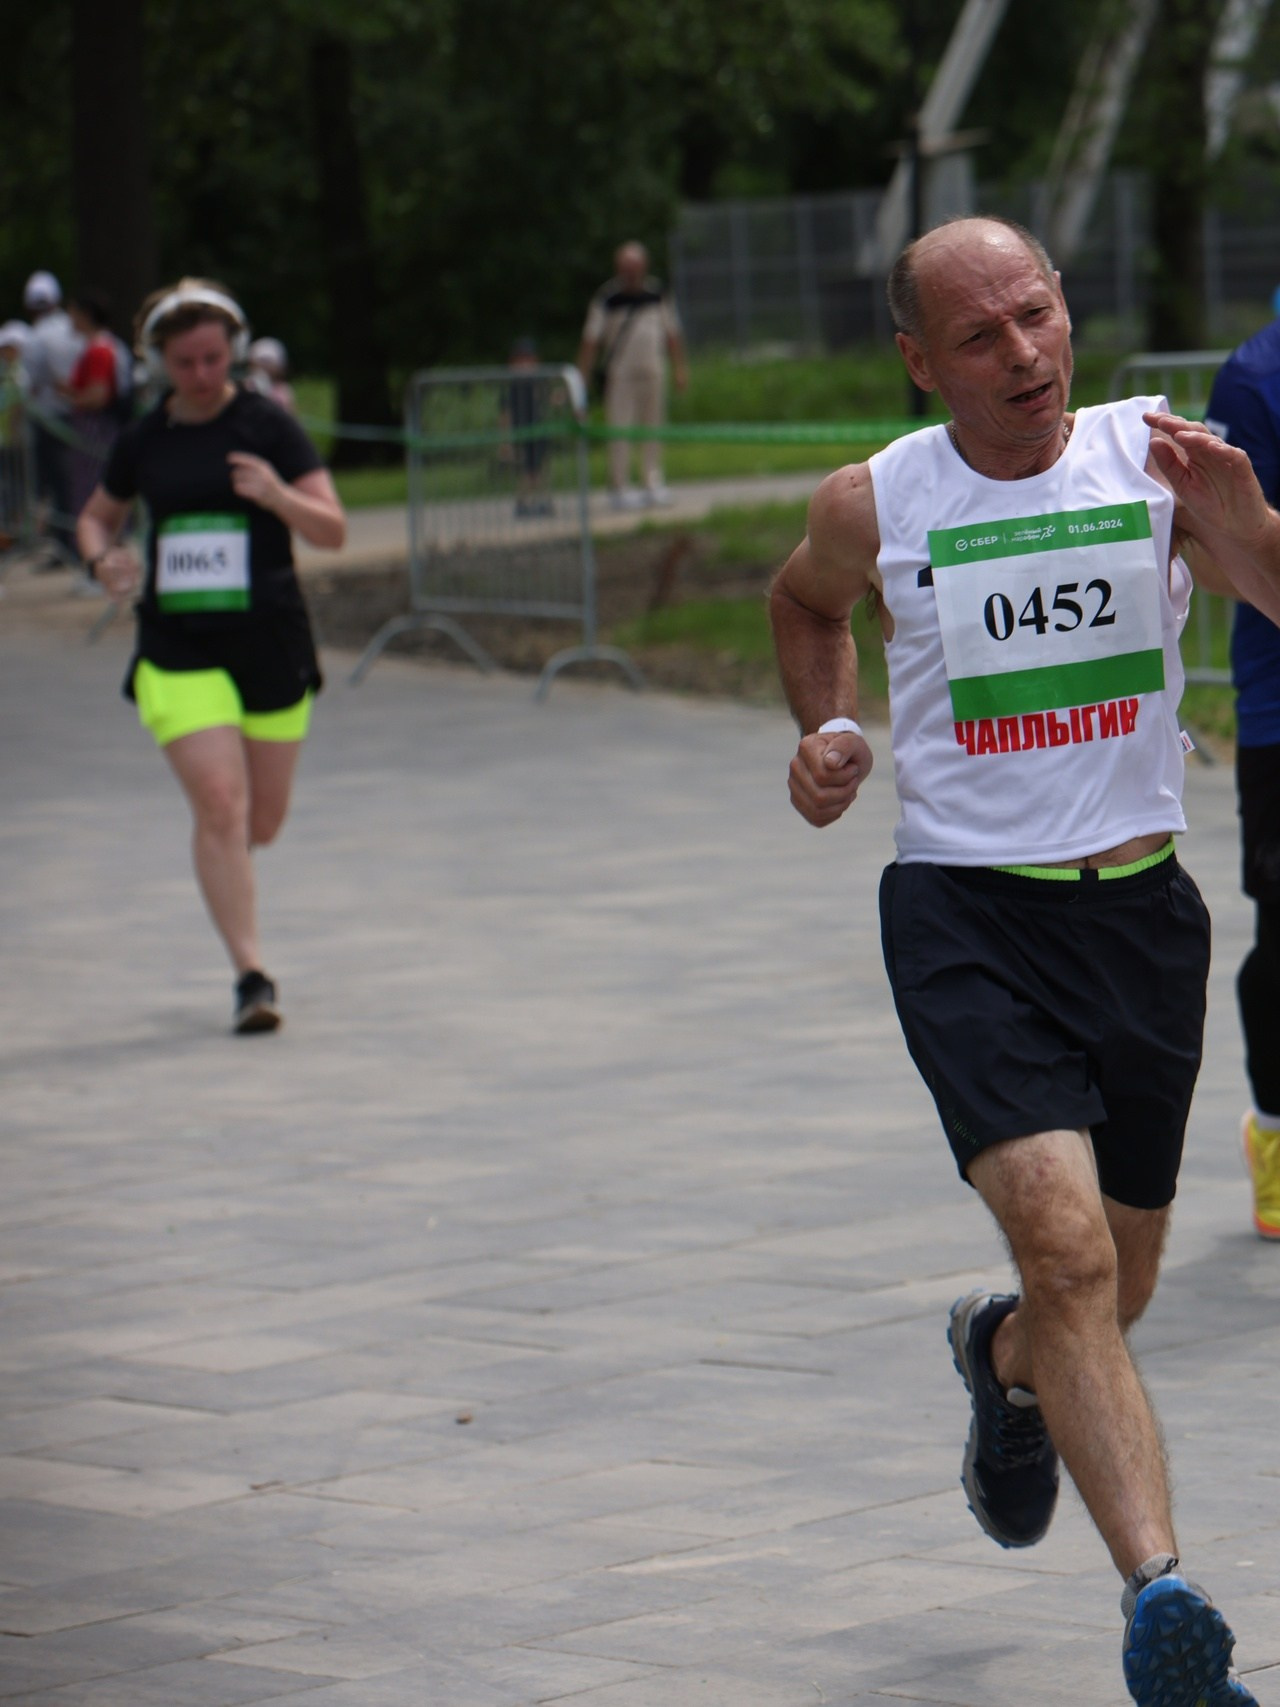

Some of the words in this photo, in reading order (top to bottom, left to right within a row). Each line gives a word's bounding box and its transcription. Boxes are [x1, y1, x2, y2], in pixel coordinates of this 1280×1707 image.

[970, 535, 998, 547] СБЕР
[1068, 519, 1123, 534] 01.06.2024
[167, 547, 227, 576] 0065
[984, 579, 1117, 641] 0452
[954, 698, 1139, 756] ЧАПЛЫГИН
